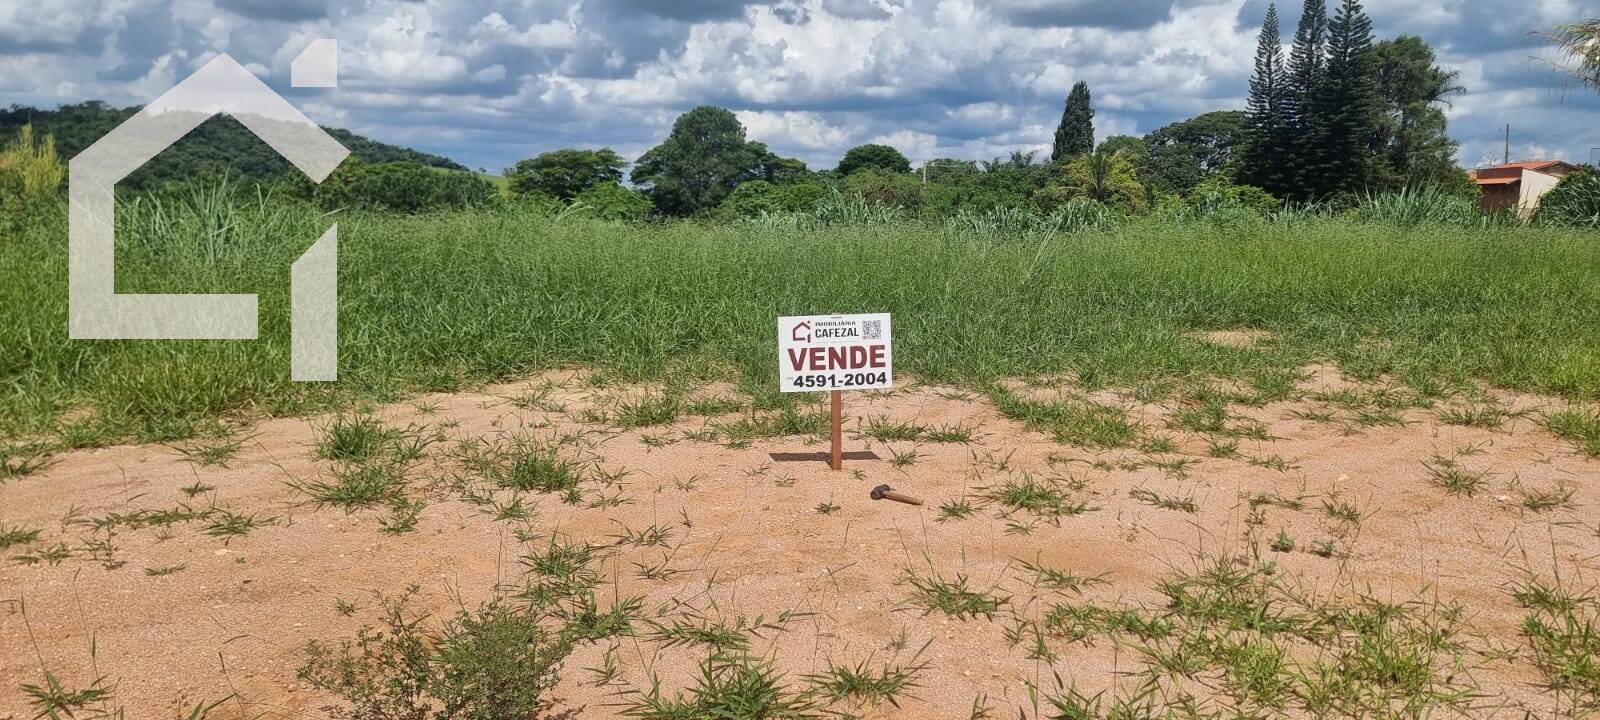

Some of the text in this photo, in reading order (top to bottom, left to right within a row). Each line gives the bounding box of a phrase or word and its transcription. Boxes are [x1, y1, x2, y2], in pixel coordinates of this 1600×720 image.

[815, 327, 859, 338] CAFEZAL
[787, 345, 886, 371] VENDE
[793, 372, 887, 387] 4591-2004
